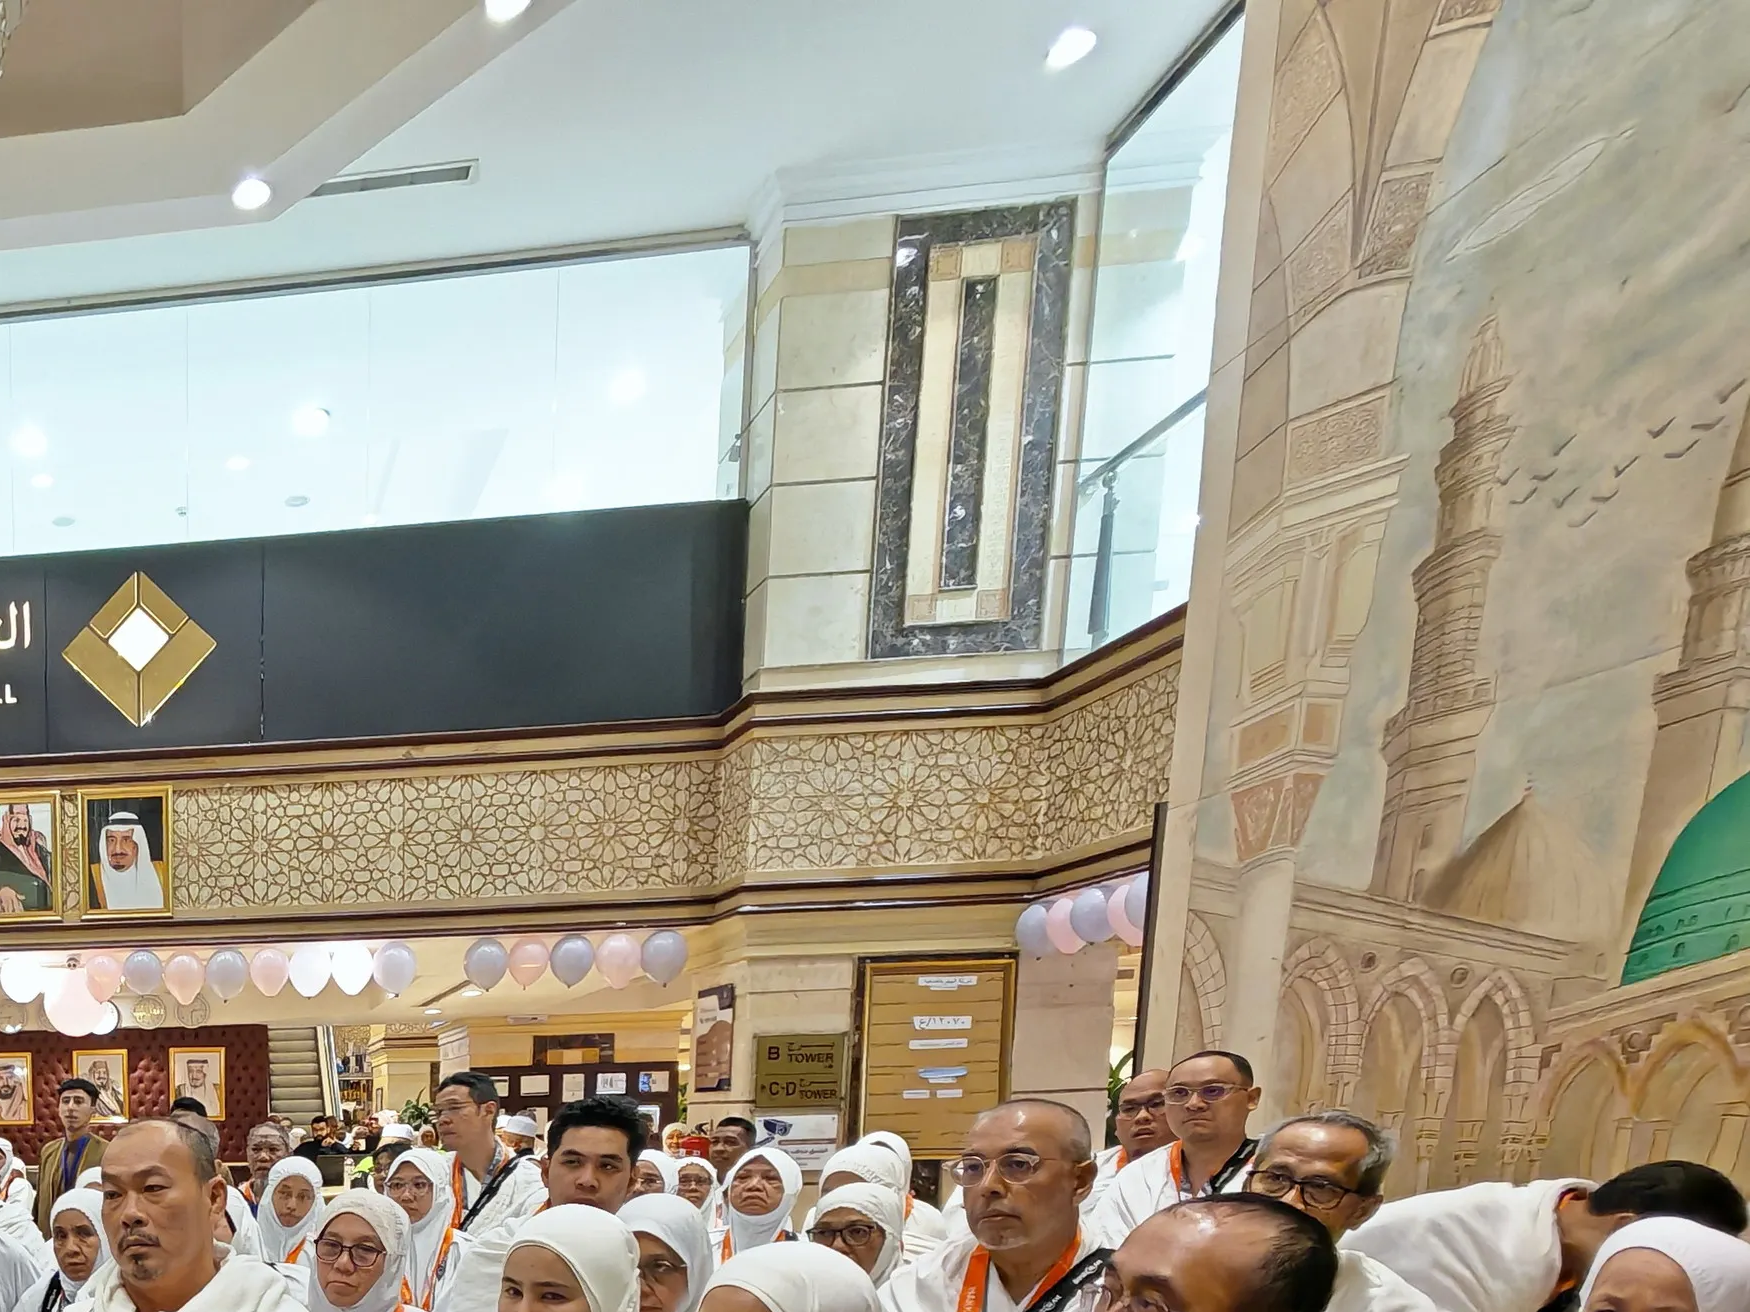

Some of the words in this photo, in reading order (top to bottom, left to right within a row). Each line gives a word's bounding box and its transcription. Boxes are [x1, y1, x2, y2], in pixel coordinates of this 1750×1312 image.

[767, 1045, 781, 1061] B
[787, 1052, 834, 1064] TOWER
[768, 1081, 797, 1097] C-D
[798, 1088, 838, 1100] TOWER
